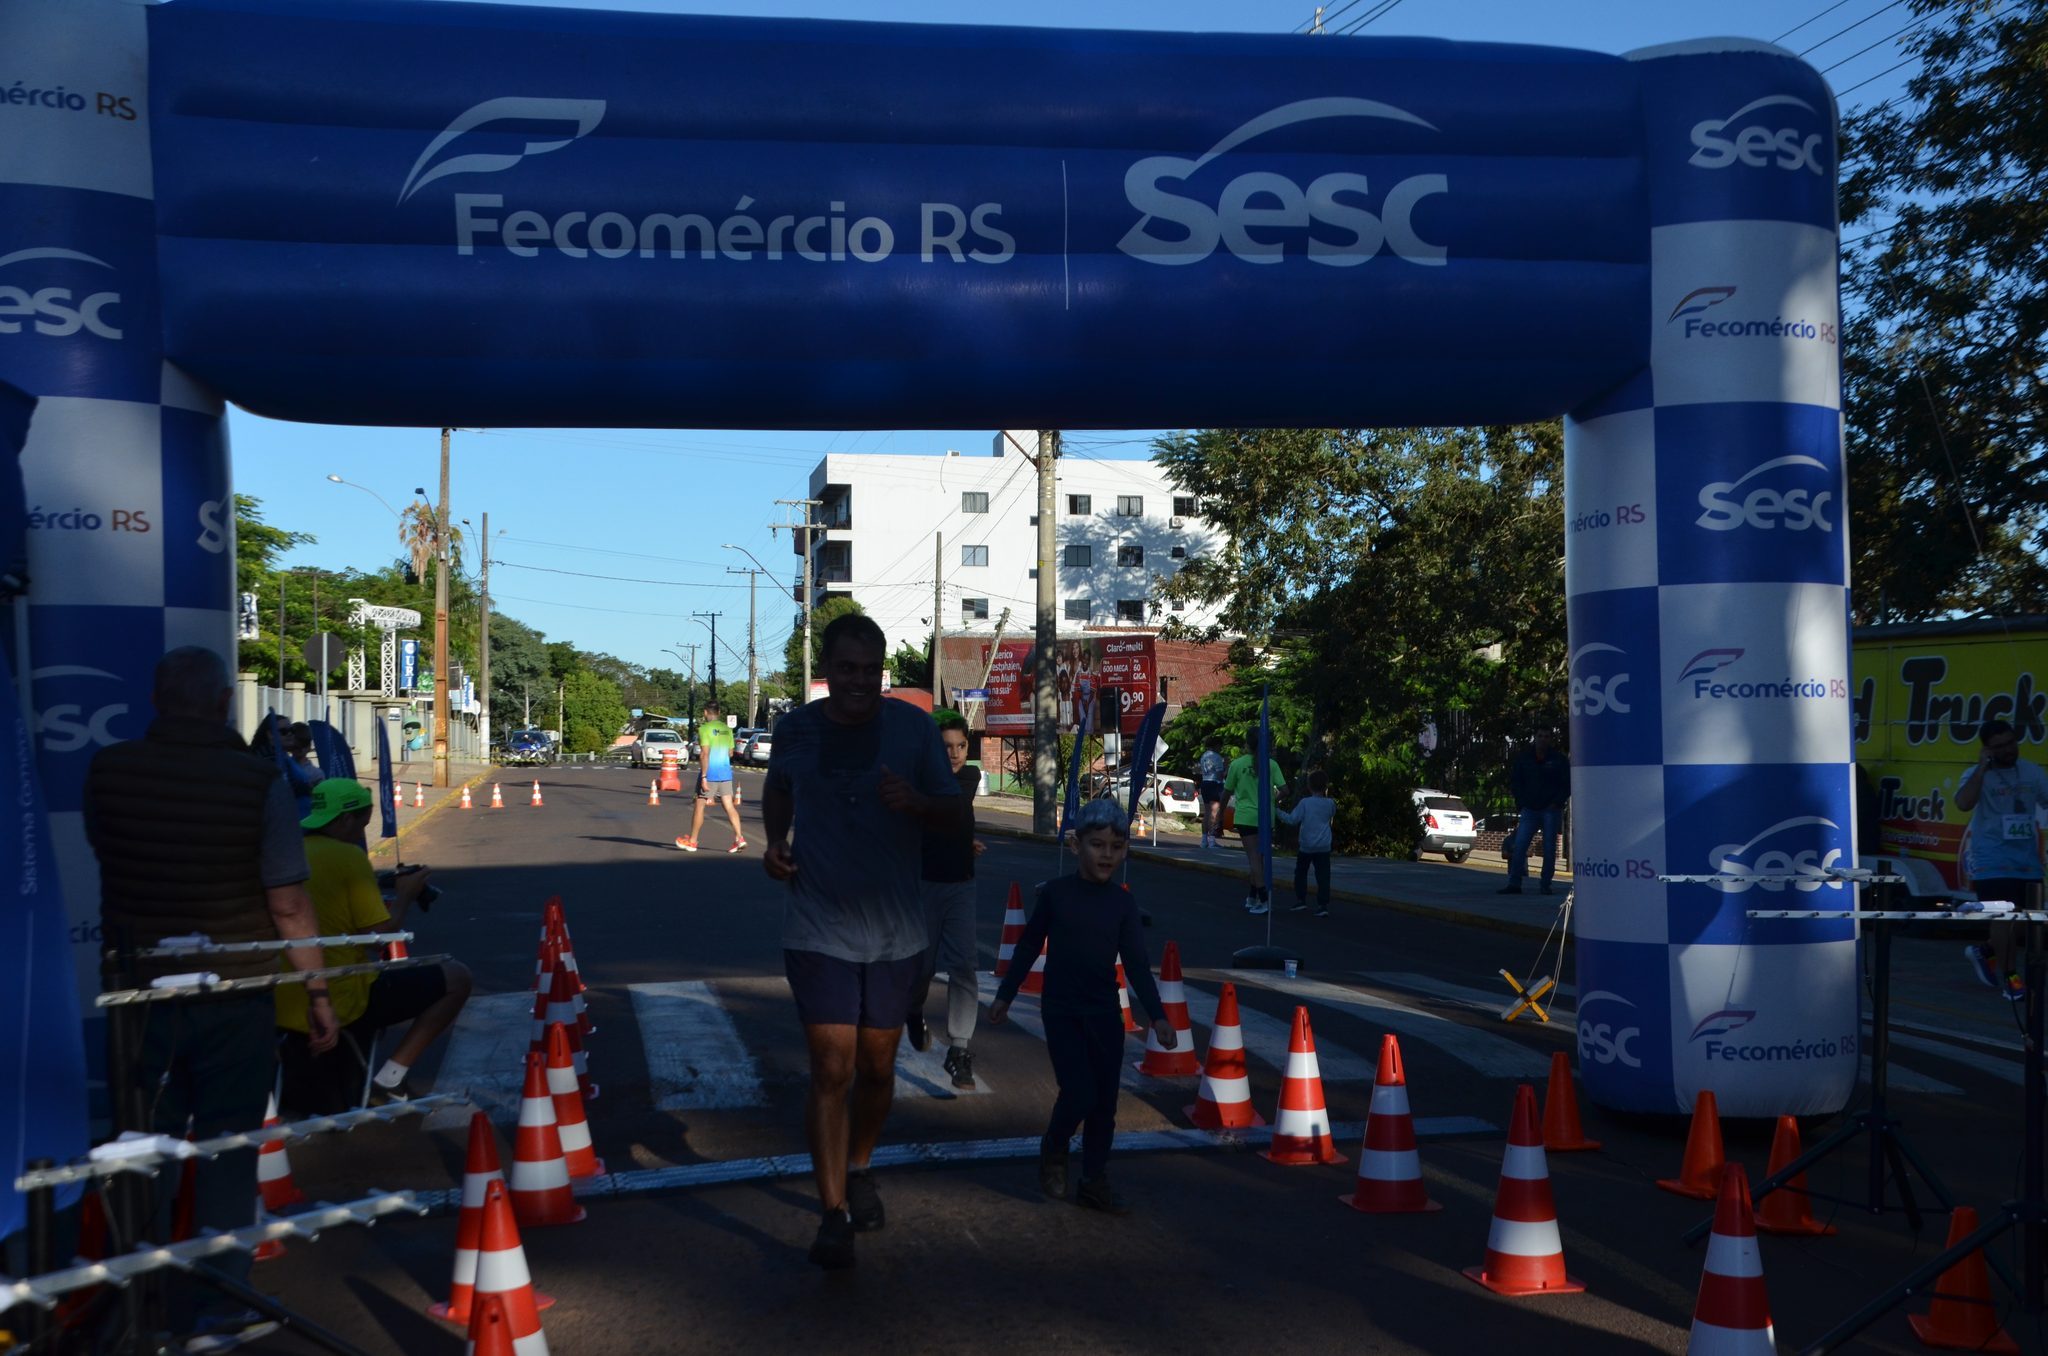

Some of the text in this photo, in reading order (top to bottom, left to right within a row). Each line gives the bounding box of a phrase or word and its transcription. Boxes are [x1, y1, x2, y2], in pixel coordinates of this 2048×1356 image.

[97, 93, 137, 120] RS
[1687, 119, 1824, 176] Sesc
[1114, 155, 1449, 267] Sesc
[454, 193, 1017, 264] Fecomércio RS
[1684, 316, 1837, 344] Fecomércio RS
[28, 506, 150, 533] ércio RS
[1616, 504, 1646, 526] RS
[1695, 481, 1832, 533] Sesc
[988, 672, 1000, 682] laro
[1114, 664, 1129, 672] MEGA
[1133, 664, 1141, 672] 60
[1694, 677, 1846, 700] Fecomércio RS
[1901, 656, 2047, 746] Truck
[31, 703, 129, 752] sc
[1879, 776, 1945, 823] Truck
[2008, 823, 2033, 837] 443
[1625, 859, 1656, 879] RS
[1704, 844, 1843, 893] Sesc
[1706, 1034, 1856, 1061] Fecomércio RS
